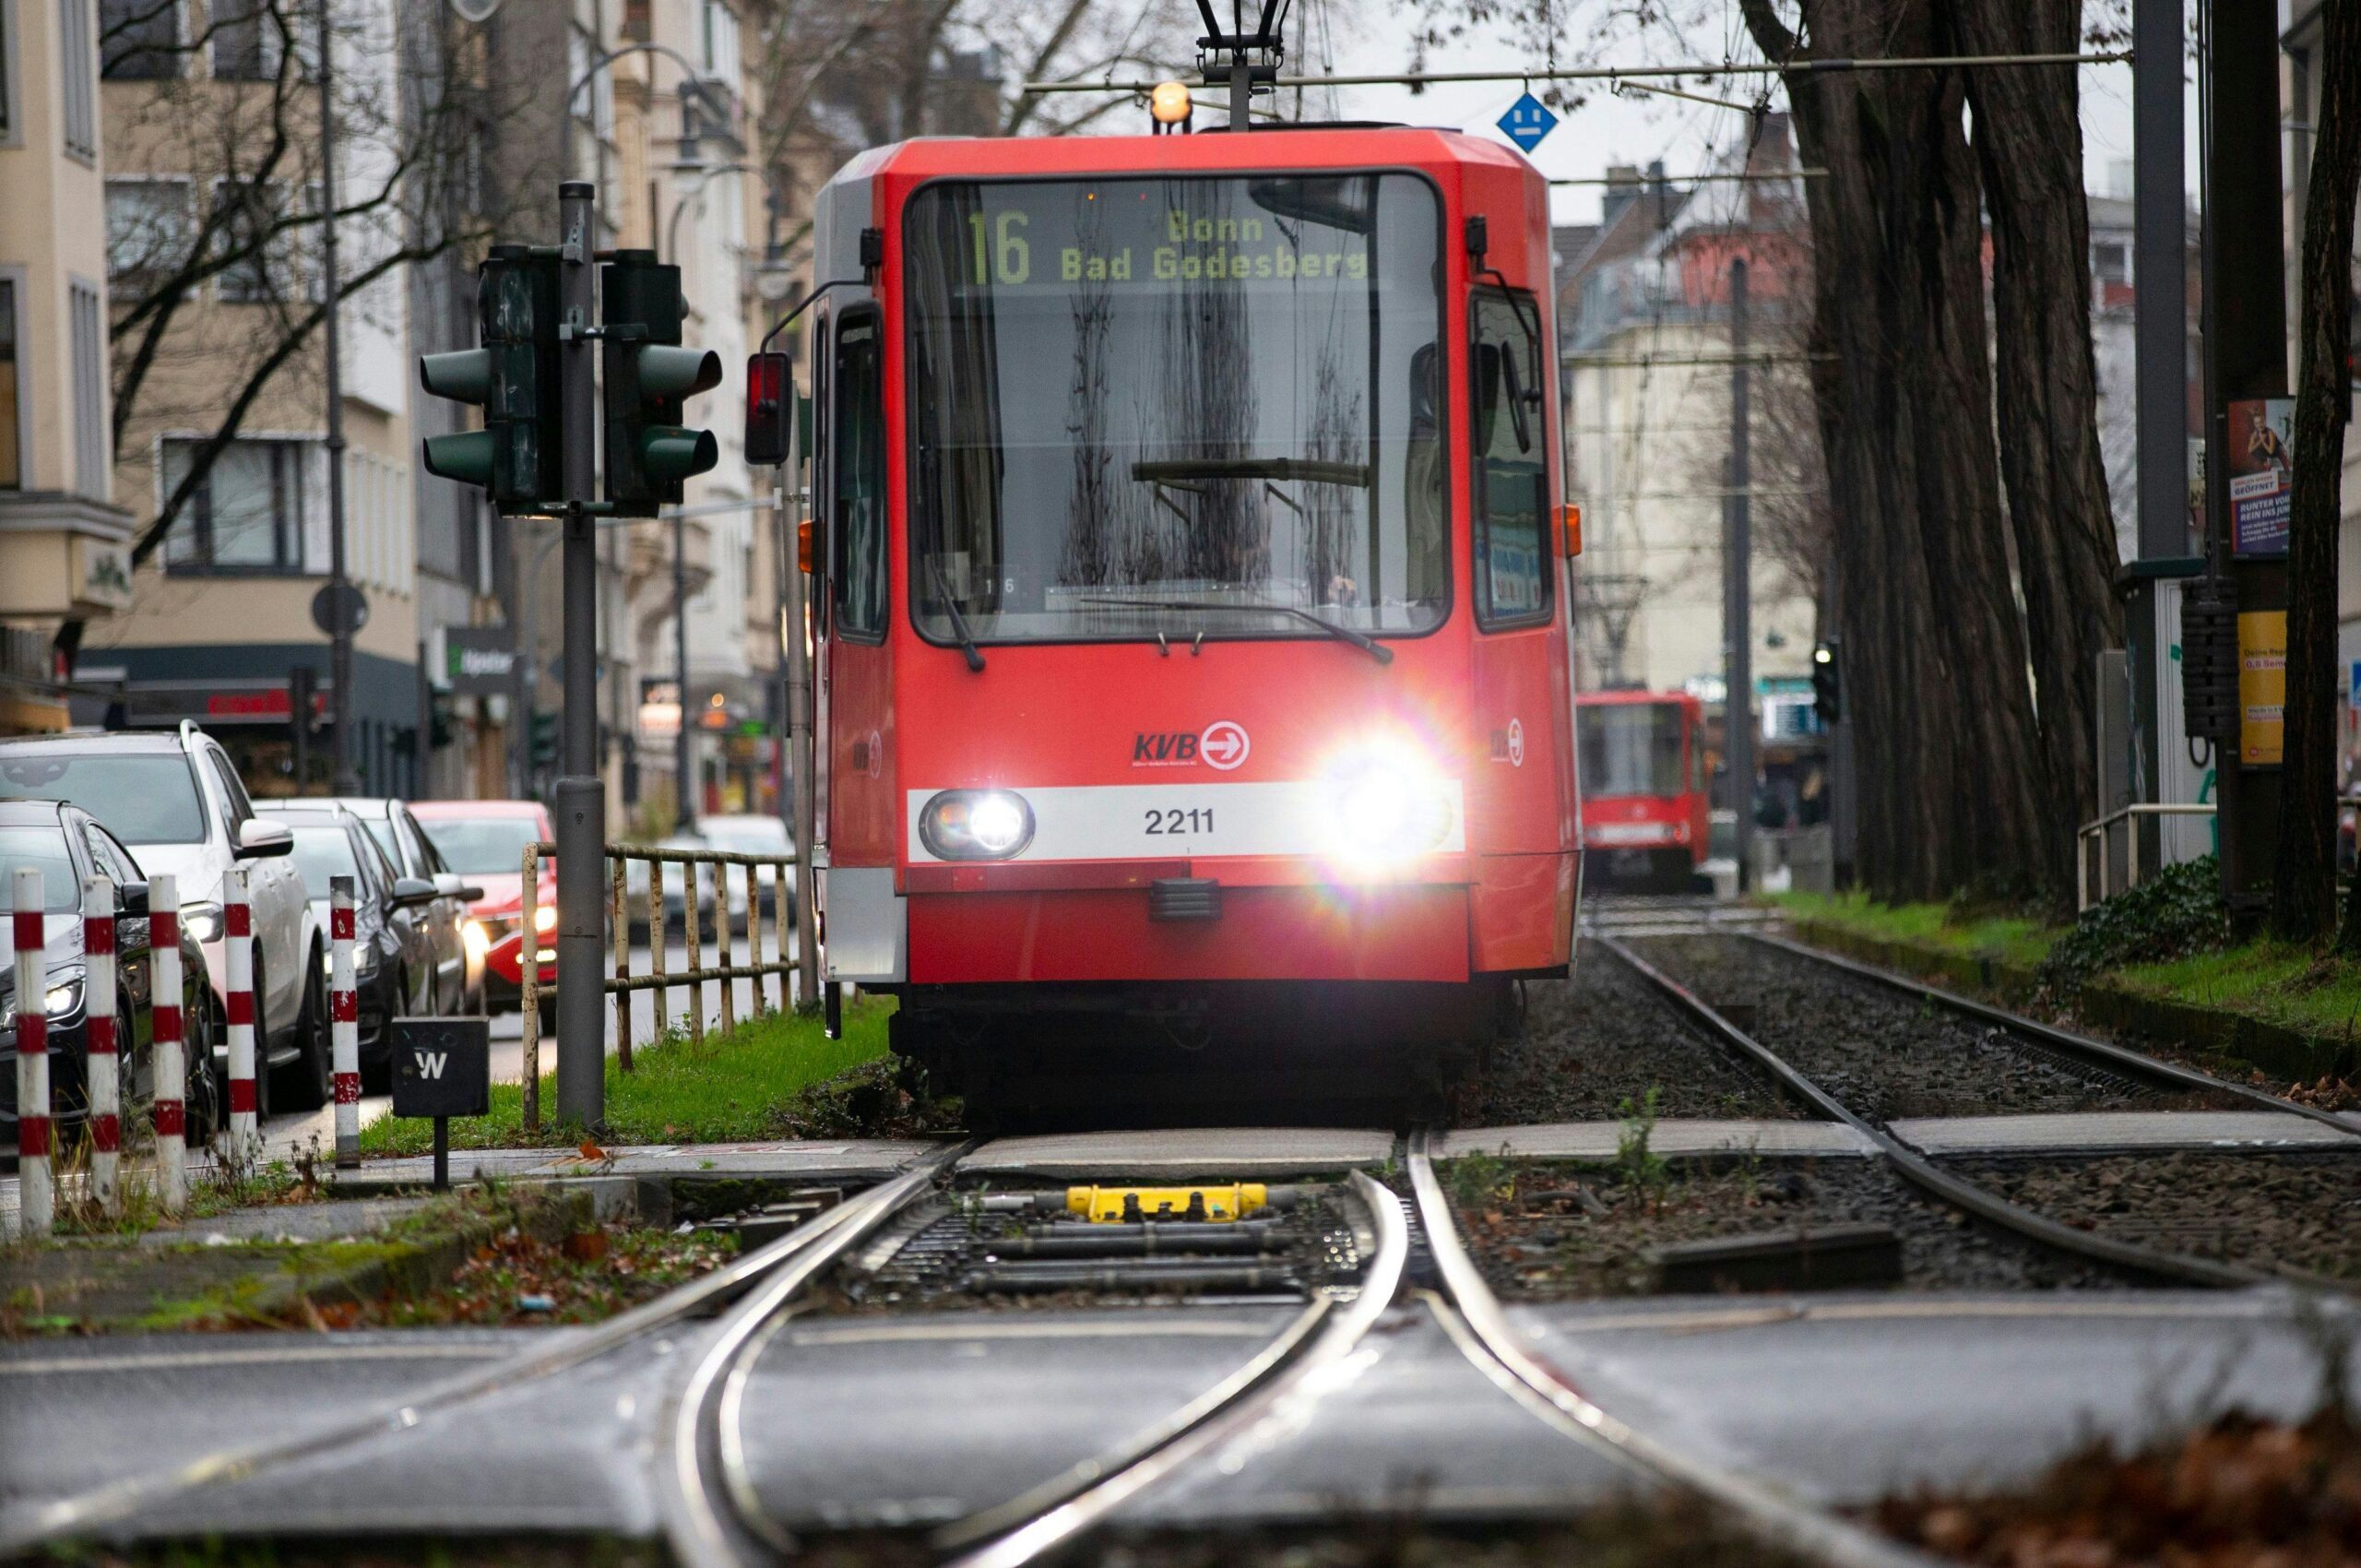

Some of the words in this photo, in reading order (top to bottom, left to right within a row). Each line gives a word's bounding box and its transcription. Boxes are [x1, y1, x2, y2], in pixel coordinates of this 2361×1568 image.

[1169, 210, 1264, 243] Bonn
[968, 211, 1029, 284] 16
[1062, 247, 1132, 280] Bad
[1154, 245, 1368, 279] Godesberg
[2235, 481, 2274, 495] GEÖFFNET
[2240, 499, 2274, 513] RUNTER
[2240, 510, 2260, 522] REIN
[2261, 507, 2276, 517] INS
[1133, 733, 1199, 761] KVB
[1145, 808, 1214, 835] 2211
[414, 1051, 448, 1080] W
